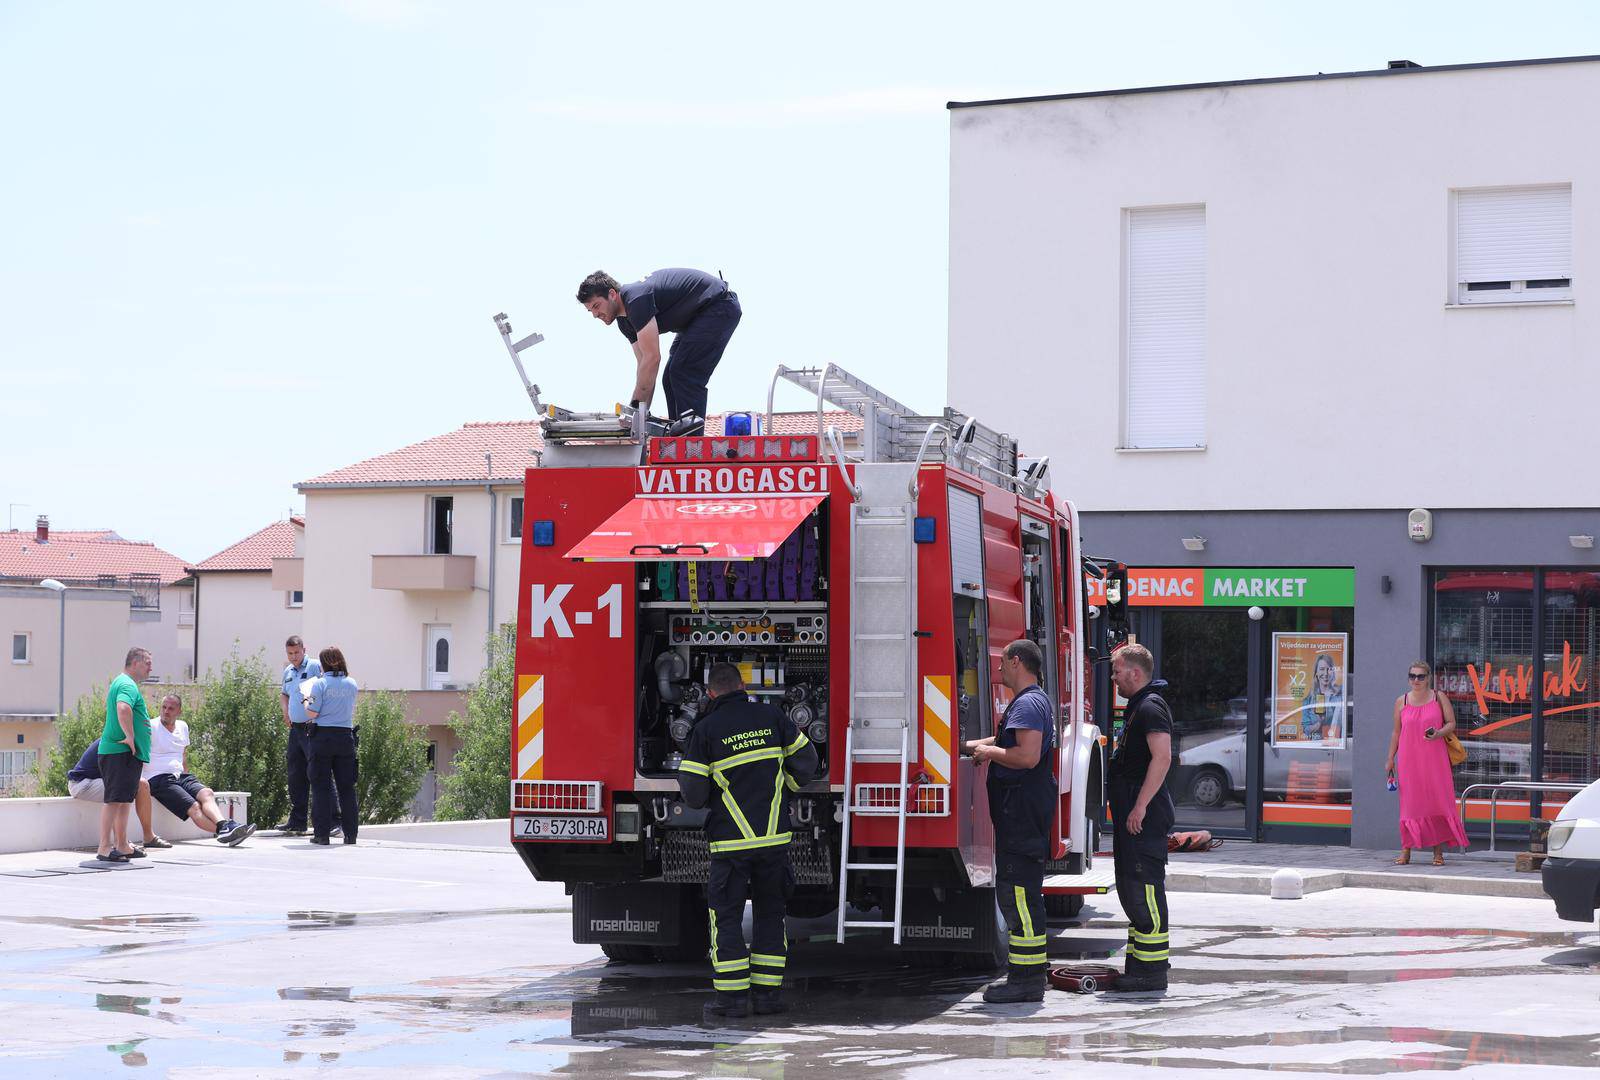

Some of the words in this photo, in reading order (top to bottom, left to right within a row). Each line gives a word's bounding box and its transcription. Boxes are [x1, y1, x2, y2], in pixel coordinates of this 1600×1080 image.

[638, 467, 829, 493] VATROGASCI
[1086, 577, 1194, 597] STDENAC
[1213, 577, 1307, 598] MARKET
[530, 583, 623, 639] K-1
[721, 729, 772, 745] VATROGASCI
[732, 739, 766, 751] KAŠTELA
[524, 819, 541, 835] ZG
[550, 819, 605, 835] 5730-RA
[590, 909, 660, 933] rosenbauer
[902, 915, 974, 939] rosenbauer
